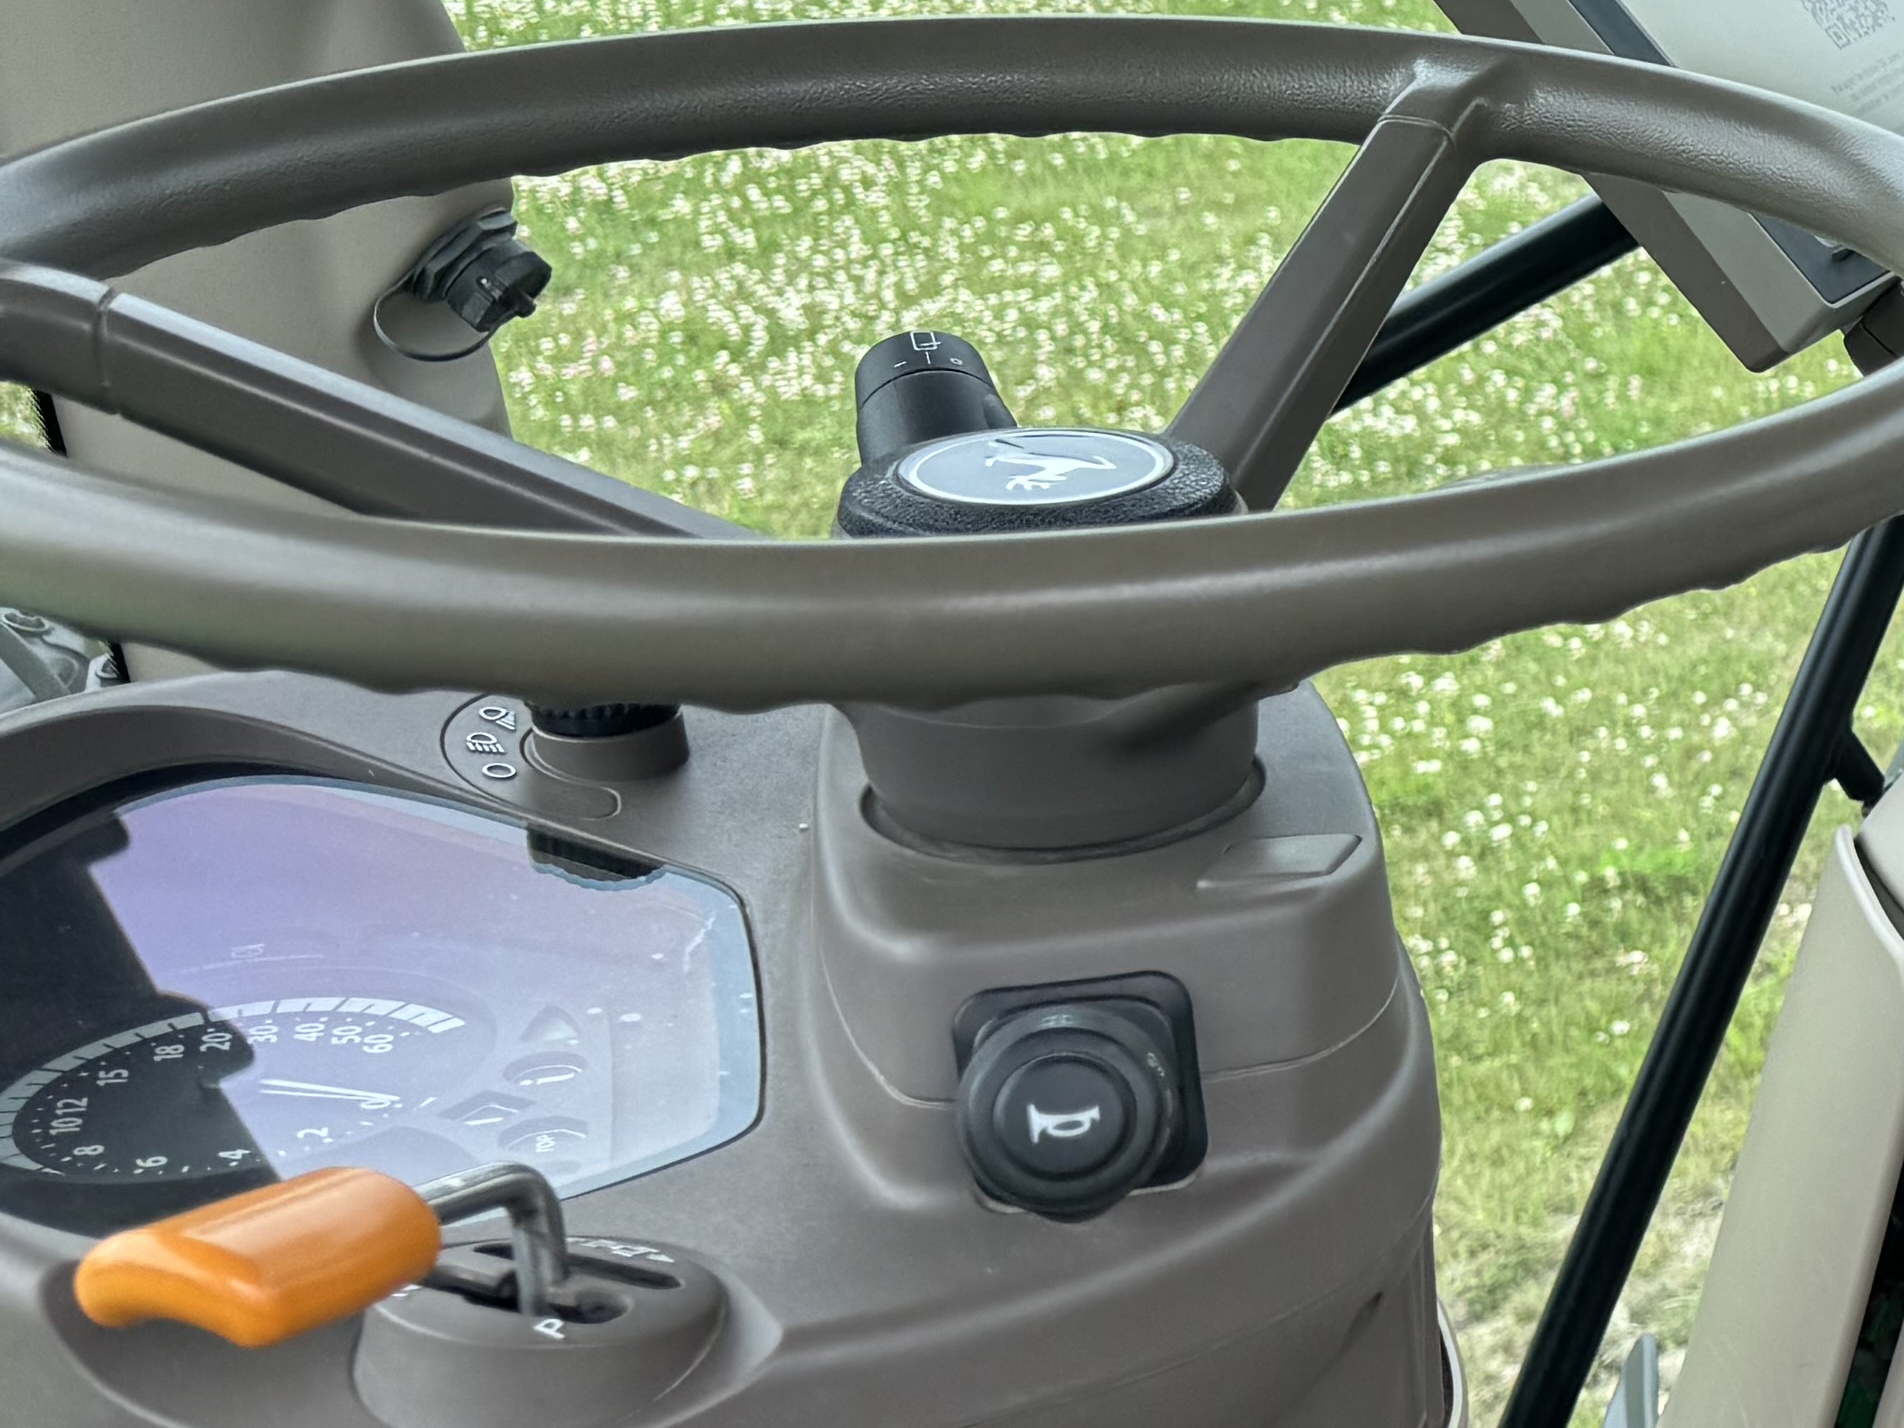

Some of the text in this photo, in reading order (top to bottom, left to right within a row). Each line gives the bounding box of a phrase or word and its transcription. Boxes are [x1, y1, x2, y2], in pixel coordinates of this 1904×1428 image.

[248, 1025, 278, 1044] 30
[294, 1023, 325, 1041] 40
[331, 1026, 362, 1044] 50
[200, 1032, 232, 1051] 20
[363, 1034, 394, 1053] 60
[153, 1044, 185, 1061] 18
[96, 1069, 129, 1086] 15
[56, 1097, 88, 1115] 12
[50, 1117, 82, 1135] 10
[297, 1127, 328, 1138] 2
[73, 1145, 104, 1156] 8
[218, 1149, 250, 1159] 4
[136, 1156, 168, 1167] 6
[533, 1318, 565, 1339] P
